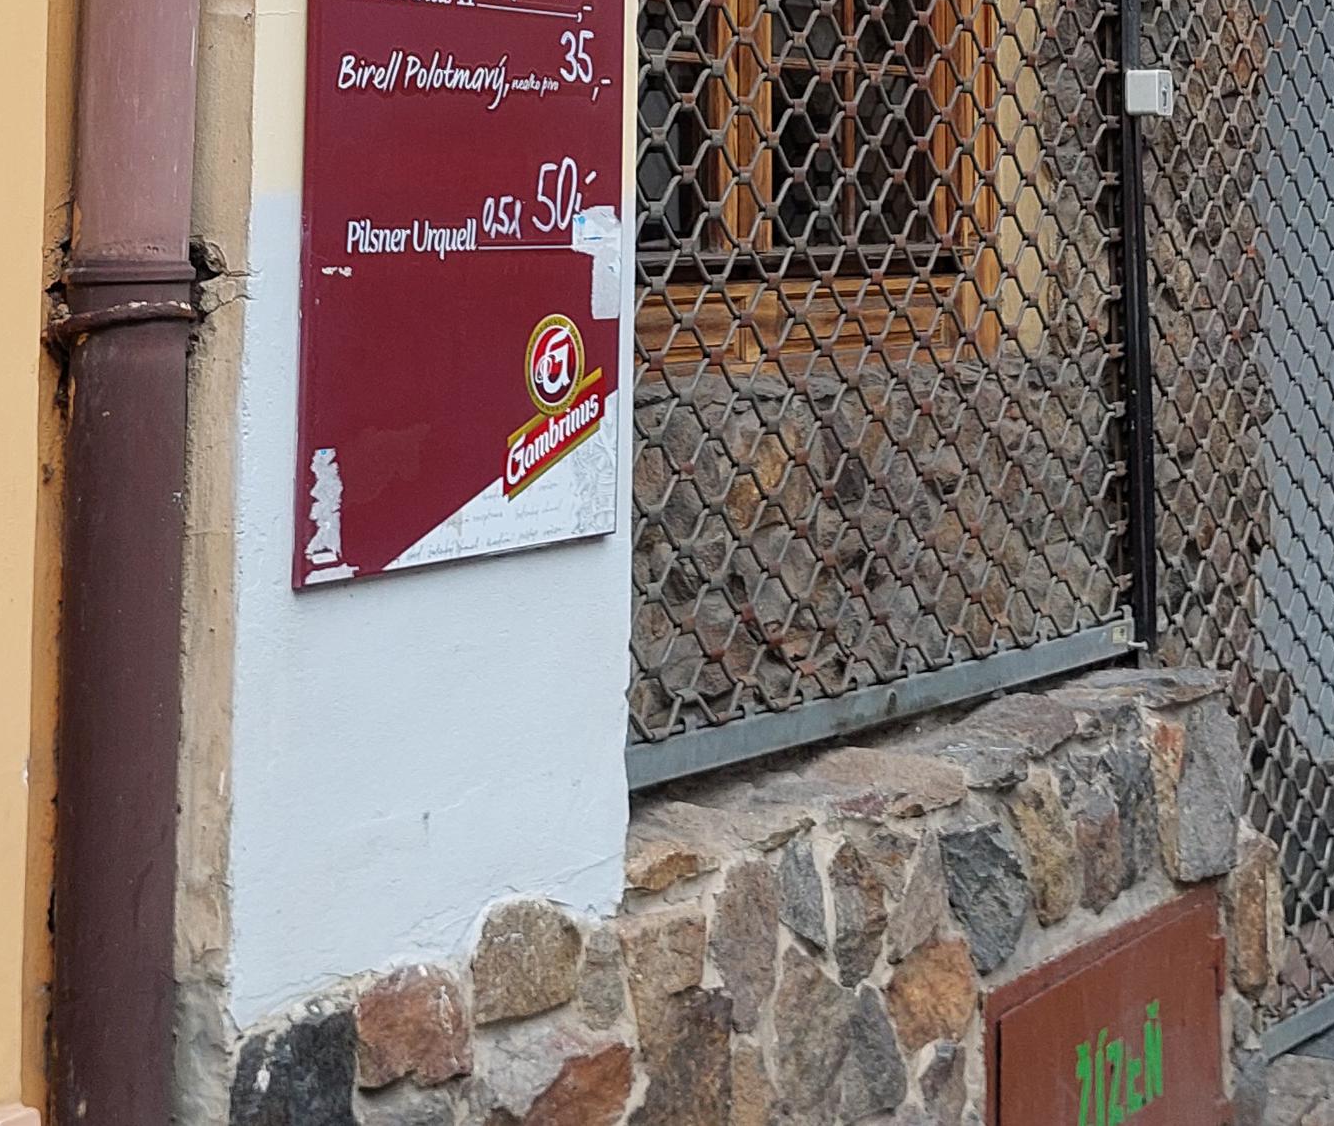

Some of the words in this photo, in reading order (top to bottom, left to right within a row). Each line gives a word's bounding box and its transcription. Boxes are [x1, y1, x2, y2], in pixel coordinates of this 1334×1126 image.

[338, 51, 402, 91] Birell
[347, 220, 411, 253] Pilsner
[413, 218, 477, 260] Urquell
[506, 393, 599, 486] Gambrinus
